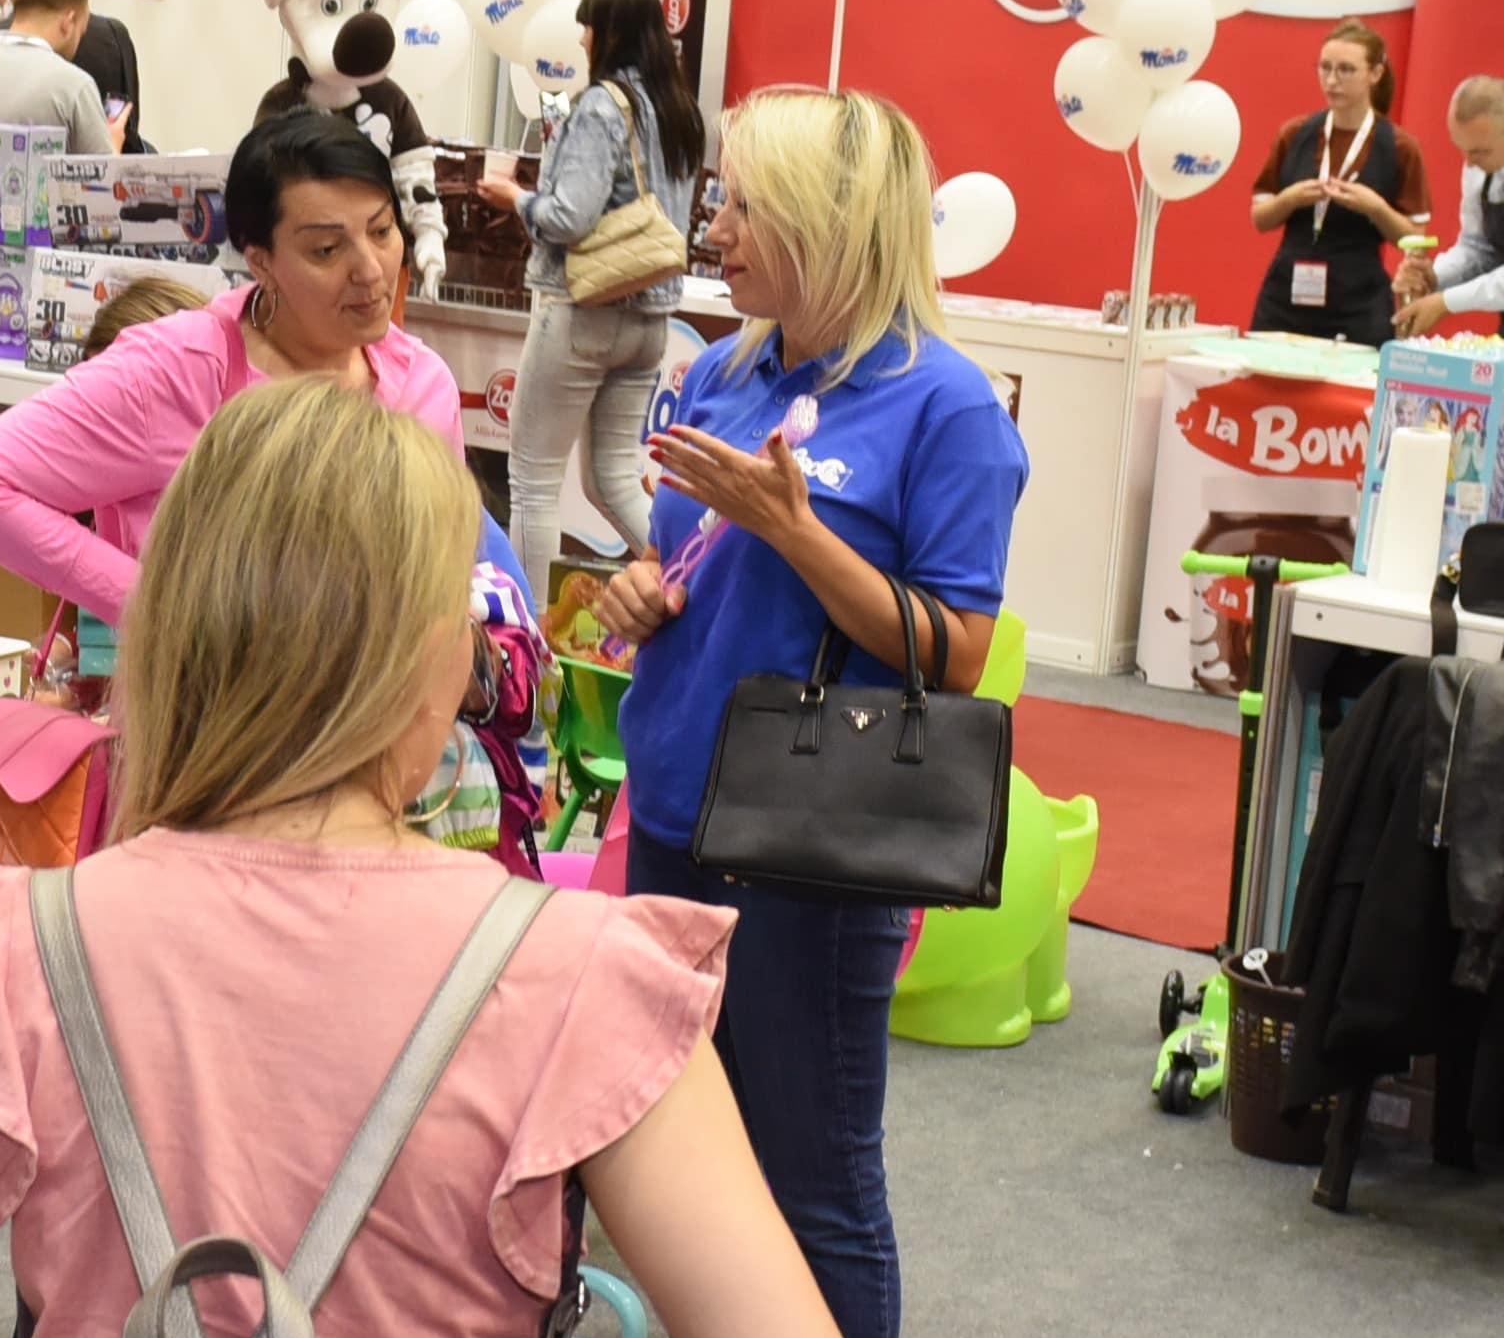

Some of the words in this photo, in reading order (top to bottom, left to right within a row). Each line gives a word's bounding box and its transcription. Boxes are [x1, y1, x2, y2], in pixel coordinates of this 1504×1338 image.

[56, 204, 89, 227] 30
[35, 299, 66, 323] 30
[1205, 405, 1241, 448] la
